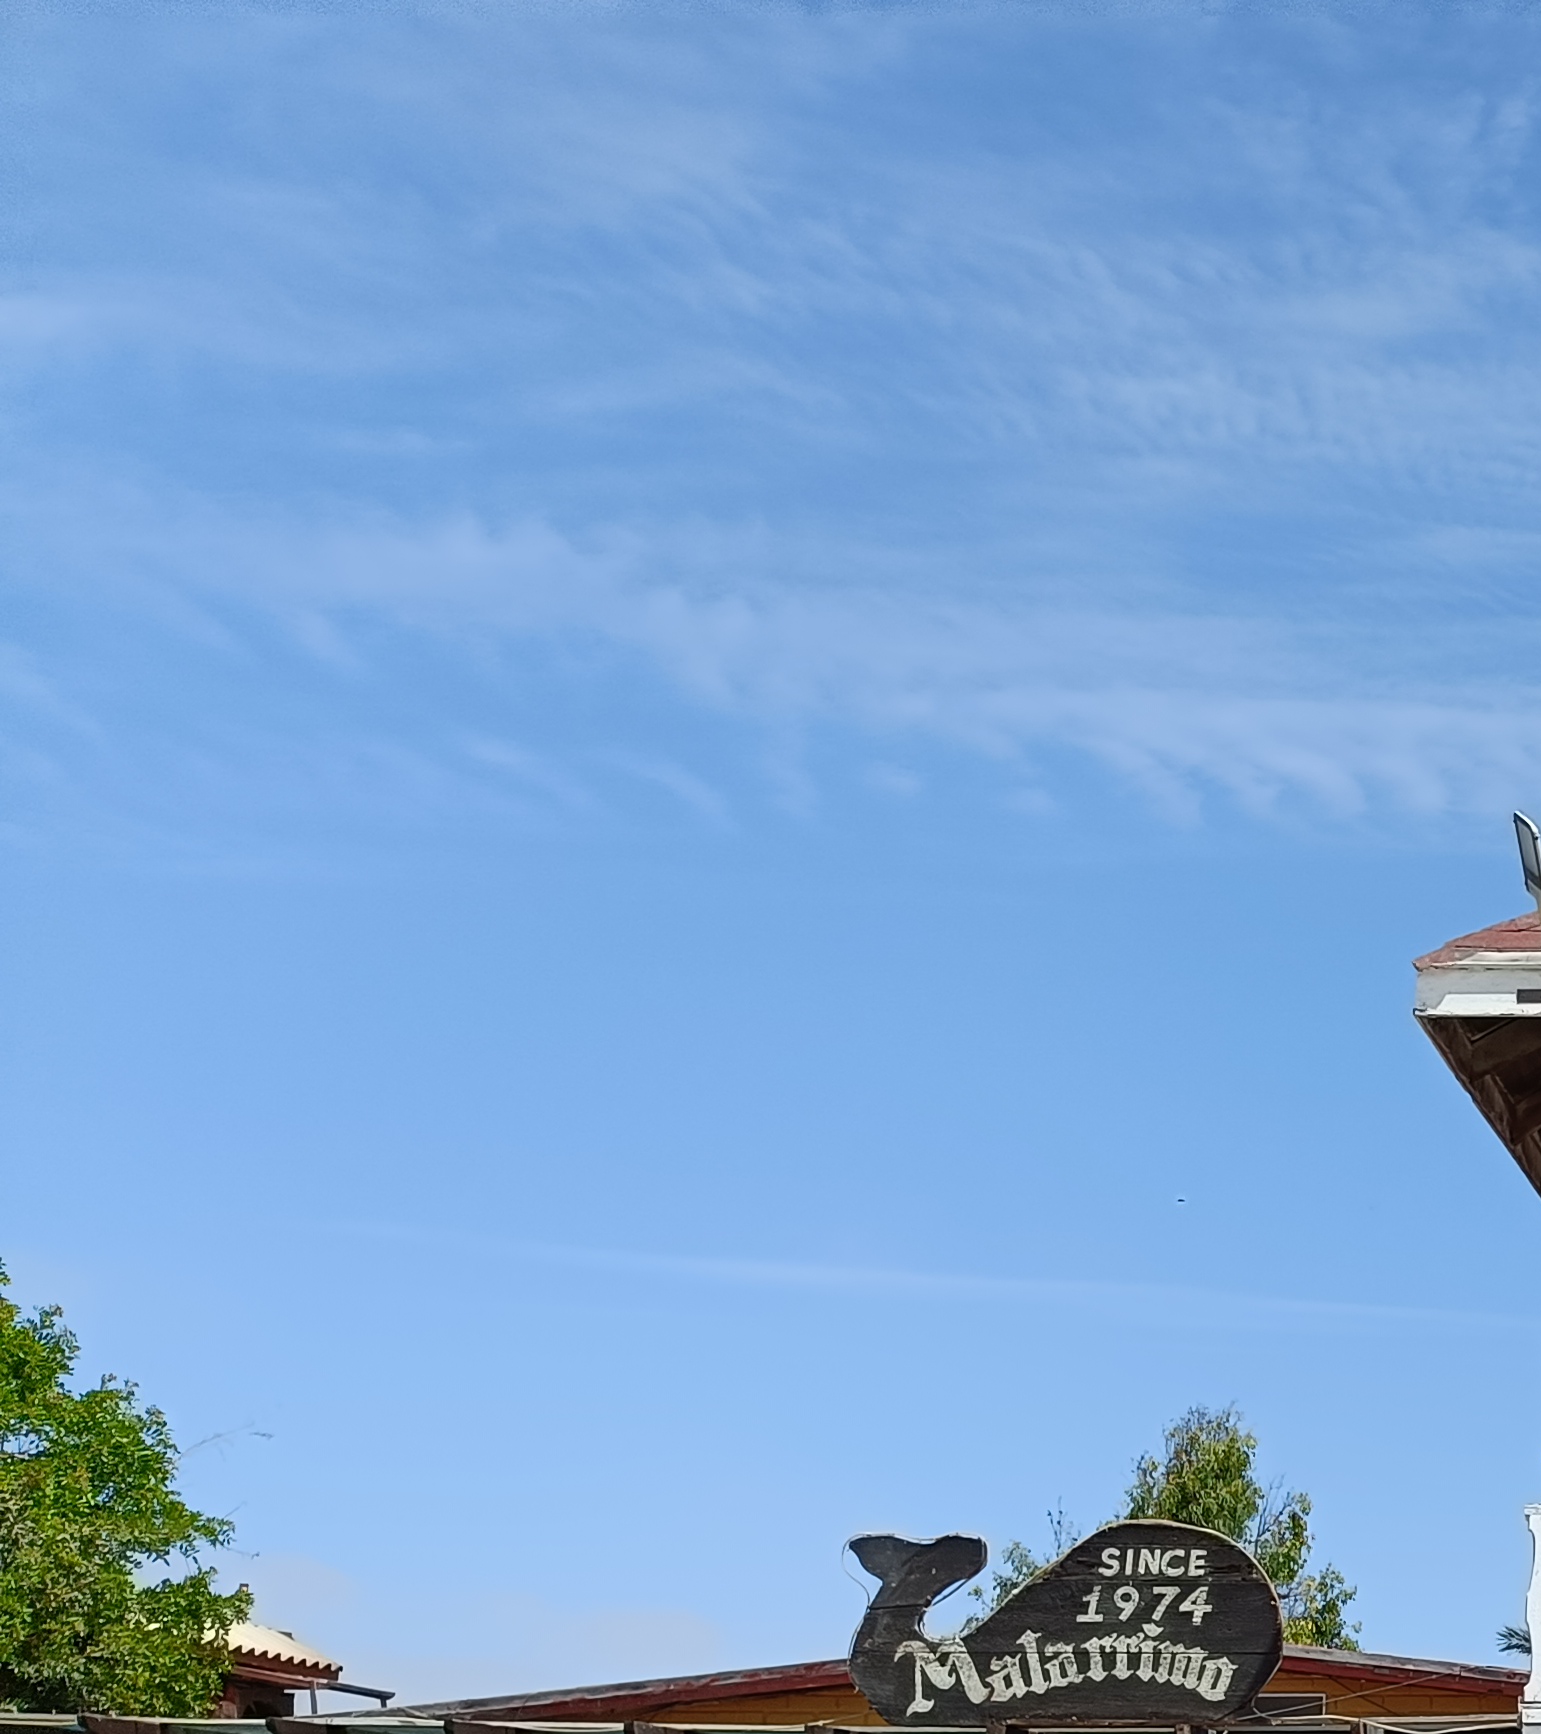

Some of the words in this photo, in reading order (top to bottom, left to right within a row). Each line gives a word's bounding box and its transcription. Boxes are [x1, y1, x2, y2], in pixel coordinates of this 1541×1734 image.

[1097, 1547, 1208, 1578] SINCE
[1075, 1585, 1214, 1626] 1974
[894, 1623, 1239, 1717] Malarrimo
